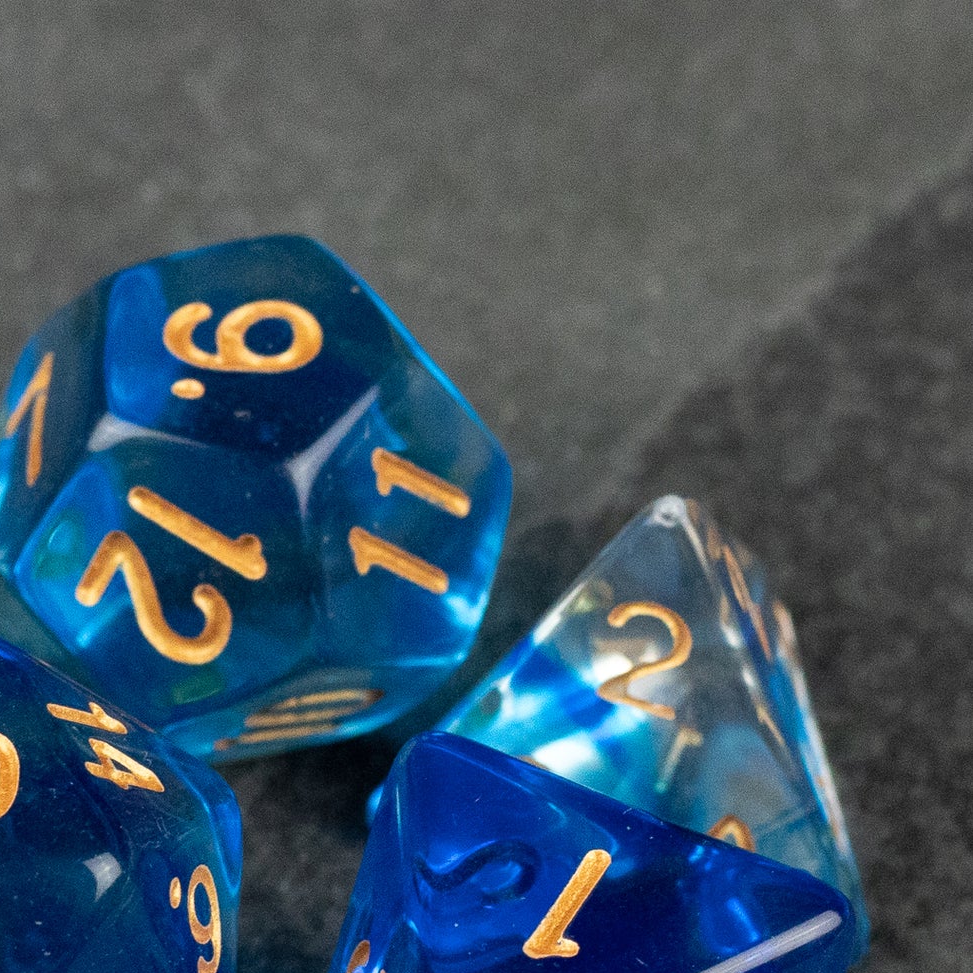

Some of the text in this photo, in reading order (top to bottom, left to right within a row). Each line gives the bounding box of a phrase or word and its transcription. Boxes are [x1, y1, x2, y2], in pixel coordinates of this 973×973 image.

[77, 487, 269, 666] 12
[350, 449, 471, 594] 11
[599, 602, 694, 721] 2
[47, 703, 166, 794] 14
[524, 850, 613, 960] 1
